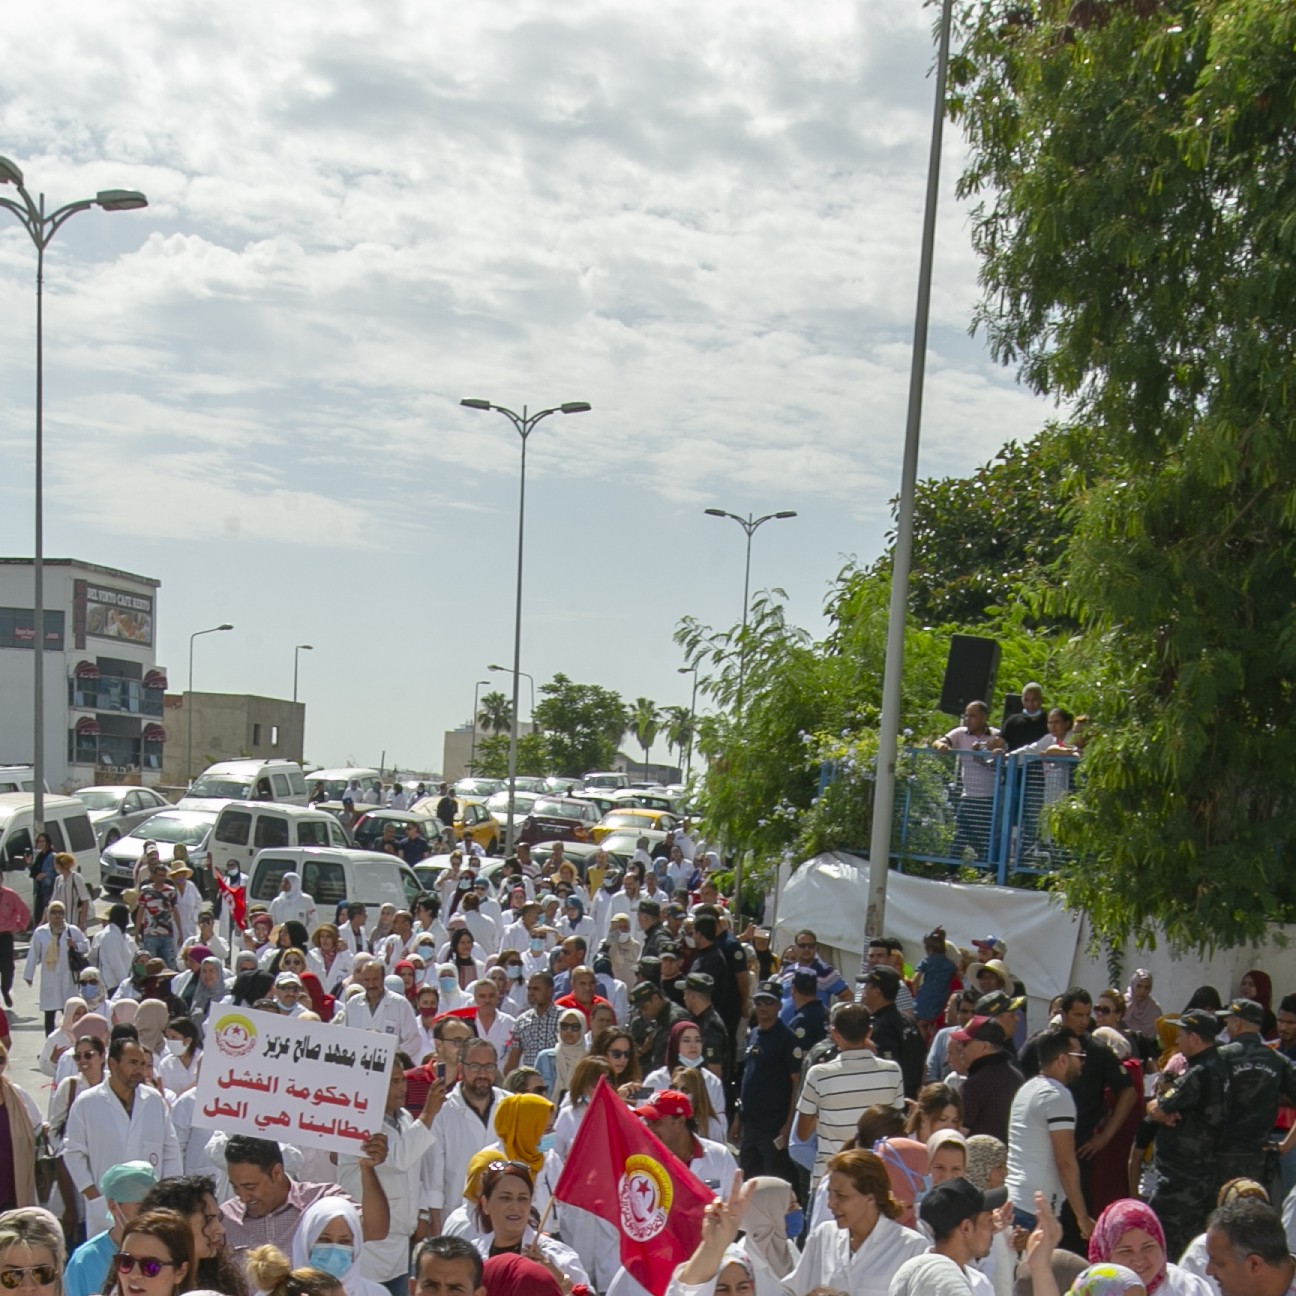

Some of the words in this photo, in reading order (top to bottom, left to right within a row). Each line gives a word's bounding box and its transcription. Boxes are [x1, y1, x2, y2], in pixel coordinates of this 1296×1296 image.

[262, 1033, 291, 1058] عزيز
[293, 1037, 321, 1062] صالح
[324, 1043, 356, 1067] معهد
[360, 1046, 388, 1075] نقابة
[218, 1069, 279, 1095] الفشل
[203, 1097, 249, 1119] الحل
[255, 1111, 291, 1131] هي
[298, 1112, 371, 1141] مطالبنا
